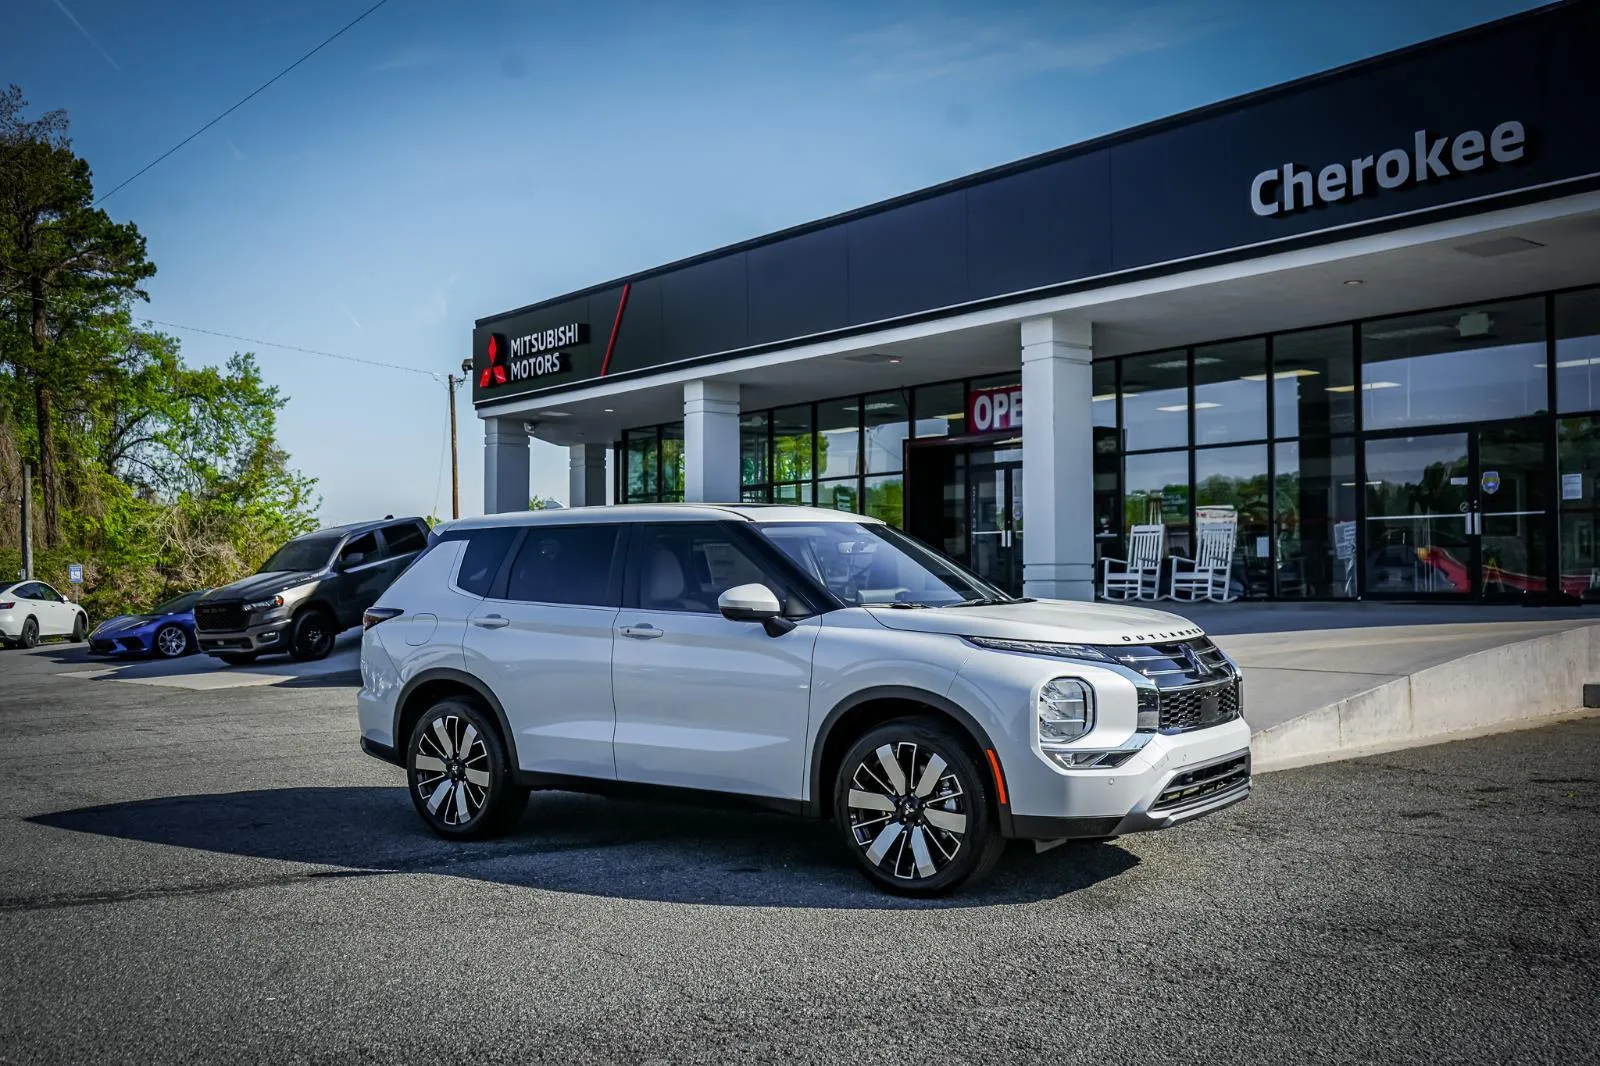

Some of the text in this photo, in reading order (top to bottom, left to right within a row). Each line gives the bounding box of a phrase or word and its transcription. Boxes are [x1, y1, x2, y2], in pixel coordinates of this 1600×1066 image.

[1250, 120, 1526, 216] Cherokee
[510, 323, 578, 358] MITSUBISHI
[510, 352, 560, 381] MOTORS
[974, 391, 1022, 430] OPE
